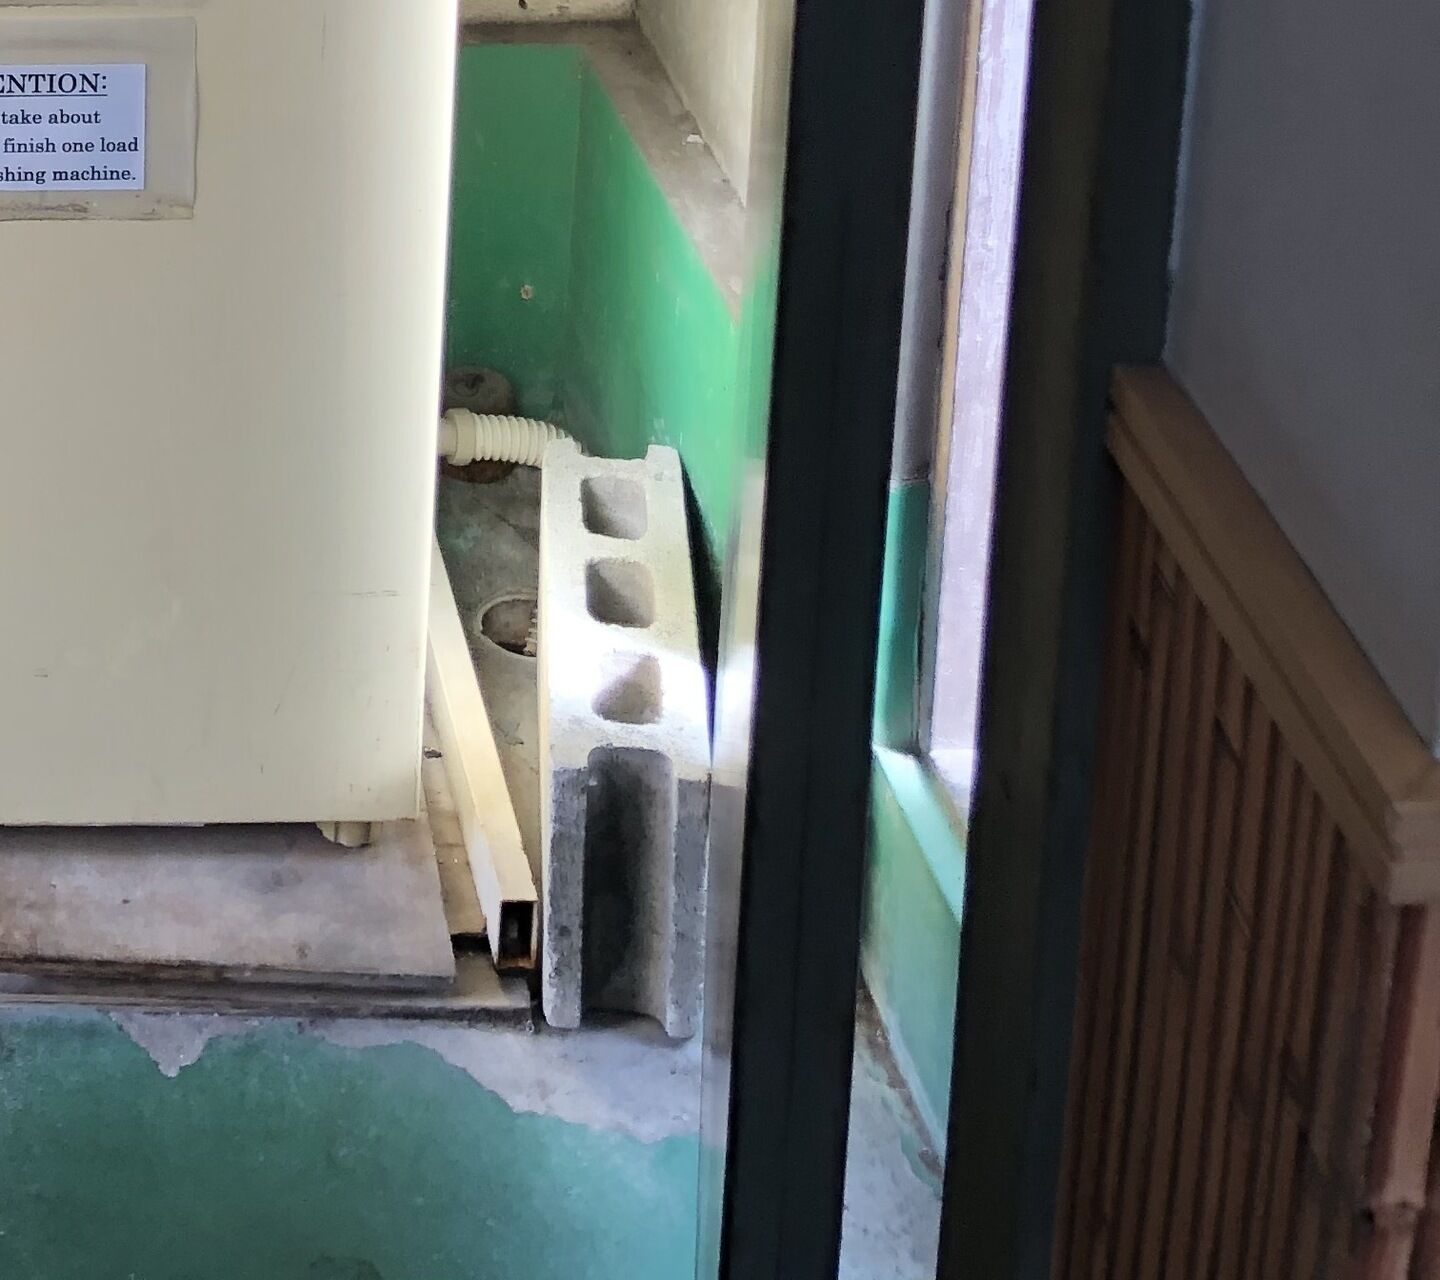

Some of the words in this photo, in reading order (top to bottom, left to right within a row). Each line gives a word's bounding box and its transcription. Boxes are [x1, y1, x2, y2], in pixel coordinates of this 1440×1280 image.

[1, 110, 42, 125] take
[48, 109, 101, 125] about
[3, 138, 56, 153] finish
[62, 141, 94, 153] one
[100, 137, 138, 153] load
[52, 167, 137, 182] machine.
